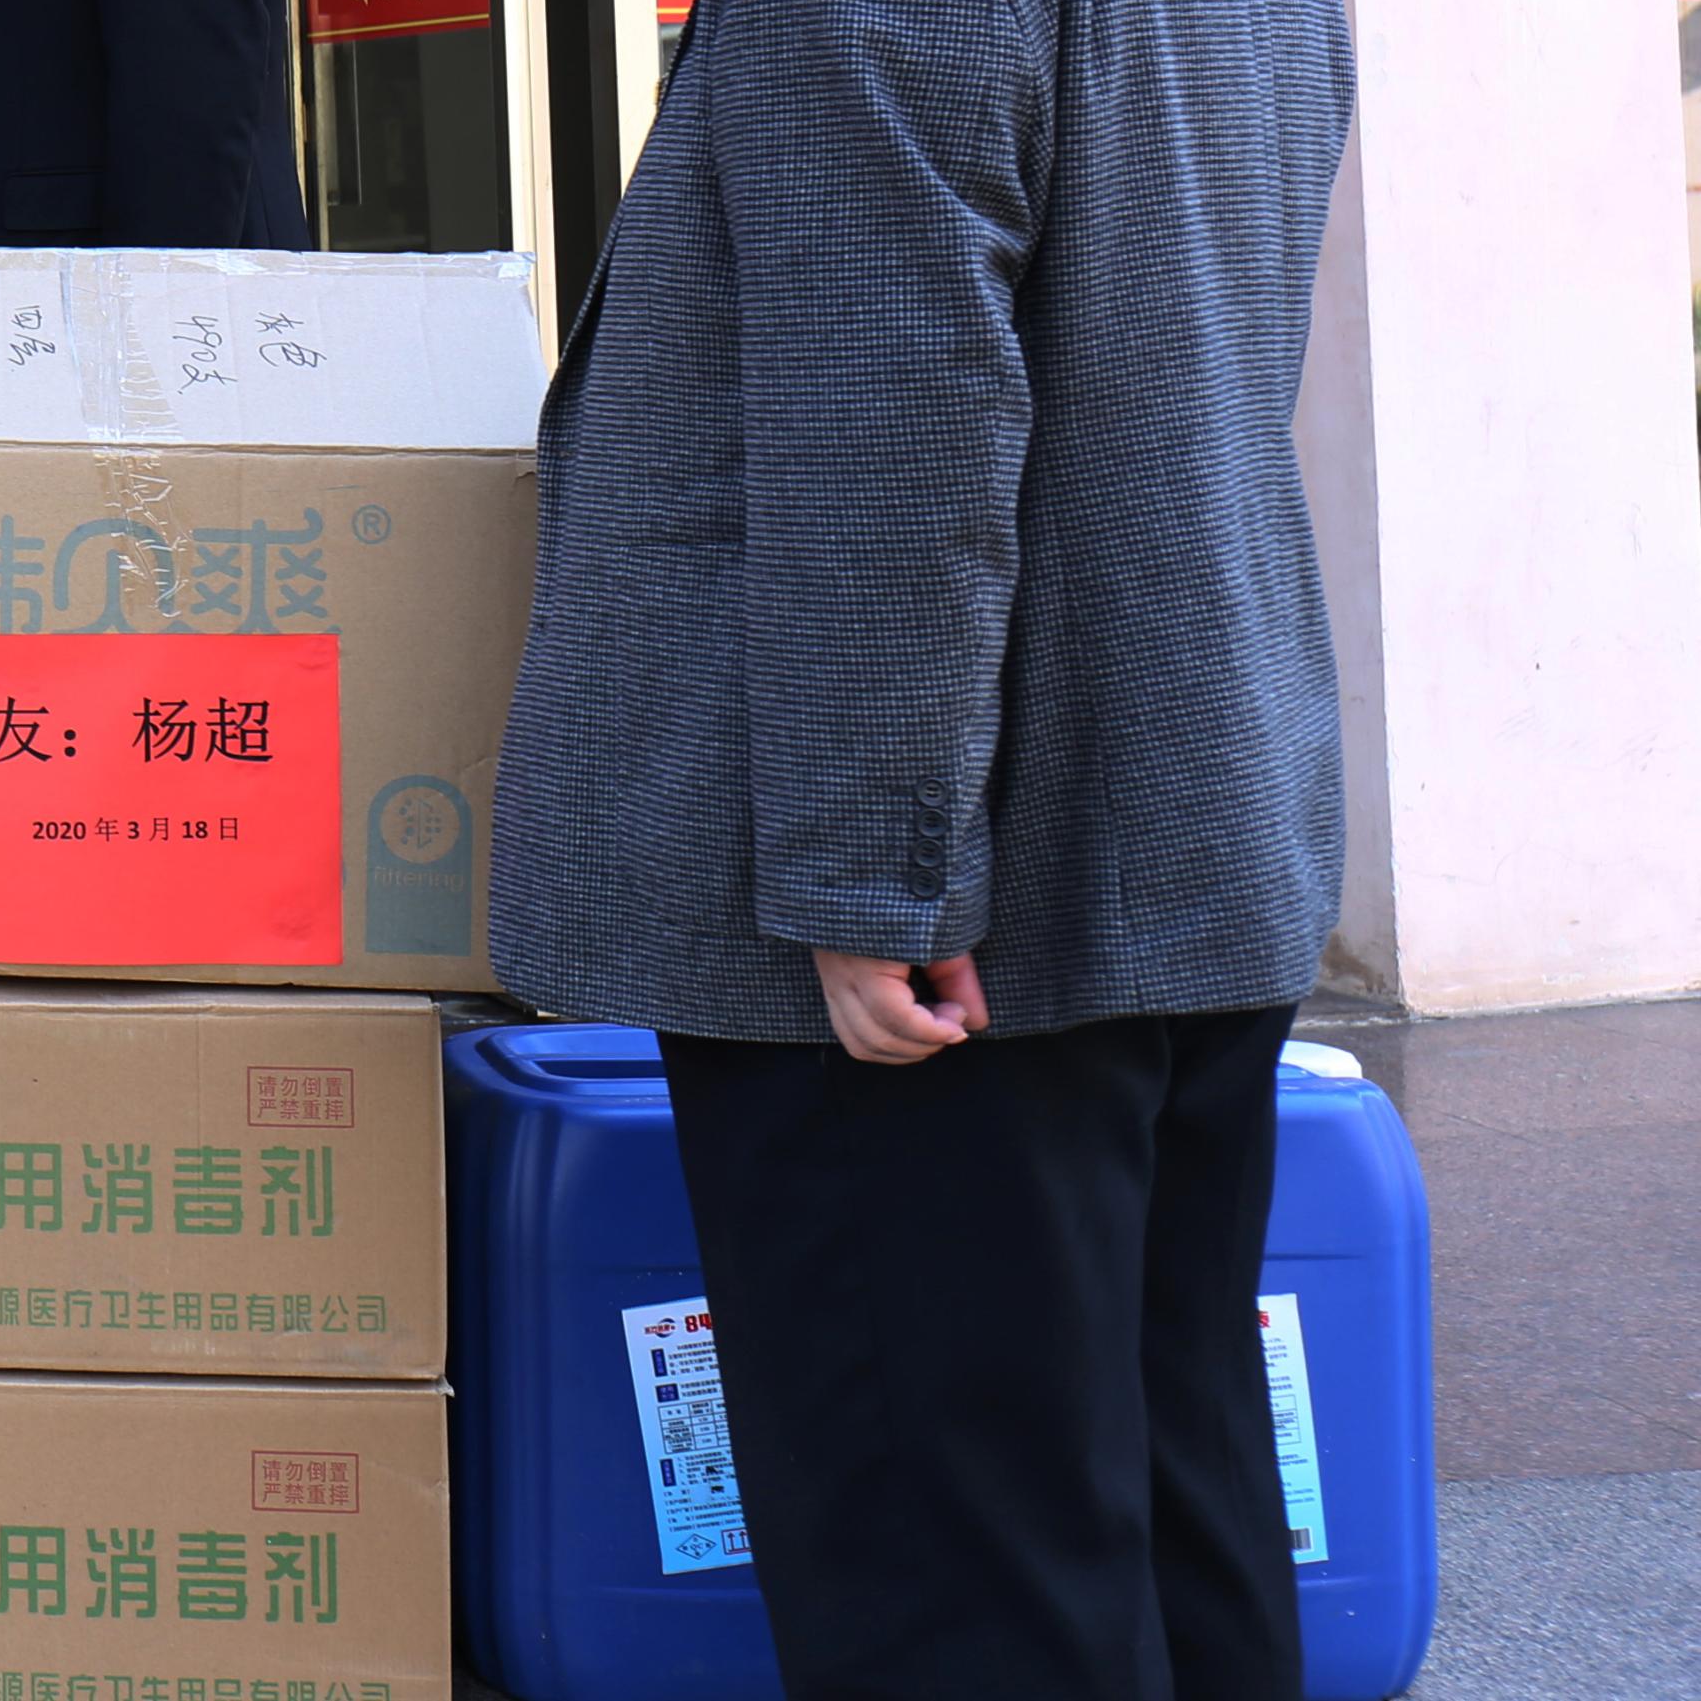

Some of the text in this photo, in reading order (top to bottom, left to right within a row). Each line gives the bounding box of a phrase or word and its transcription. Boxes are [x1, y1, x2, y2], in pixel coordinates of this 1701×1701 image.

[132, 696, 275, 764] 杨超
[374, 865, 465, 893] filtering
[257, 1074, 345, 1100] 请勿倒置
[257, 1099, 345, 1121] 严禁重摔
[262, 1459, 349, 1483] 请勿倒置
[262, 1482, 350, 1506] 严禁重摔
